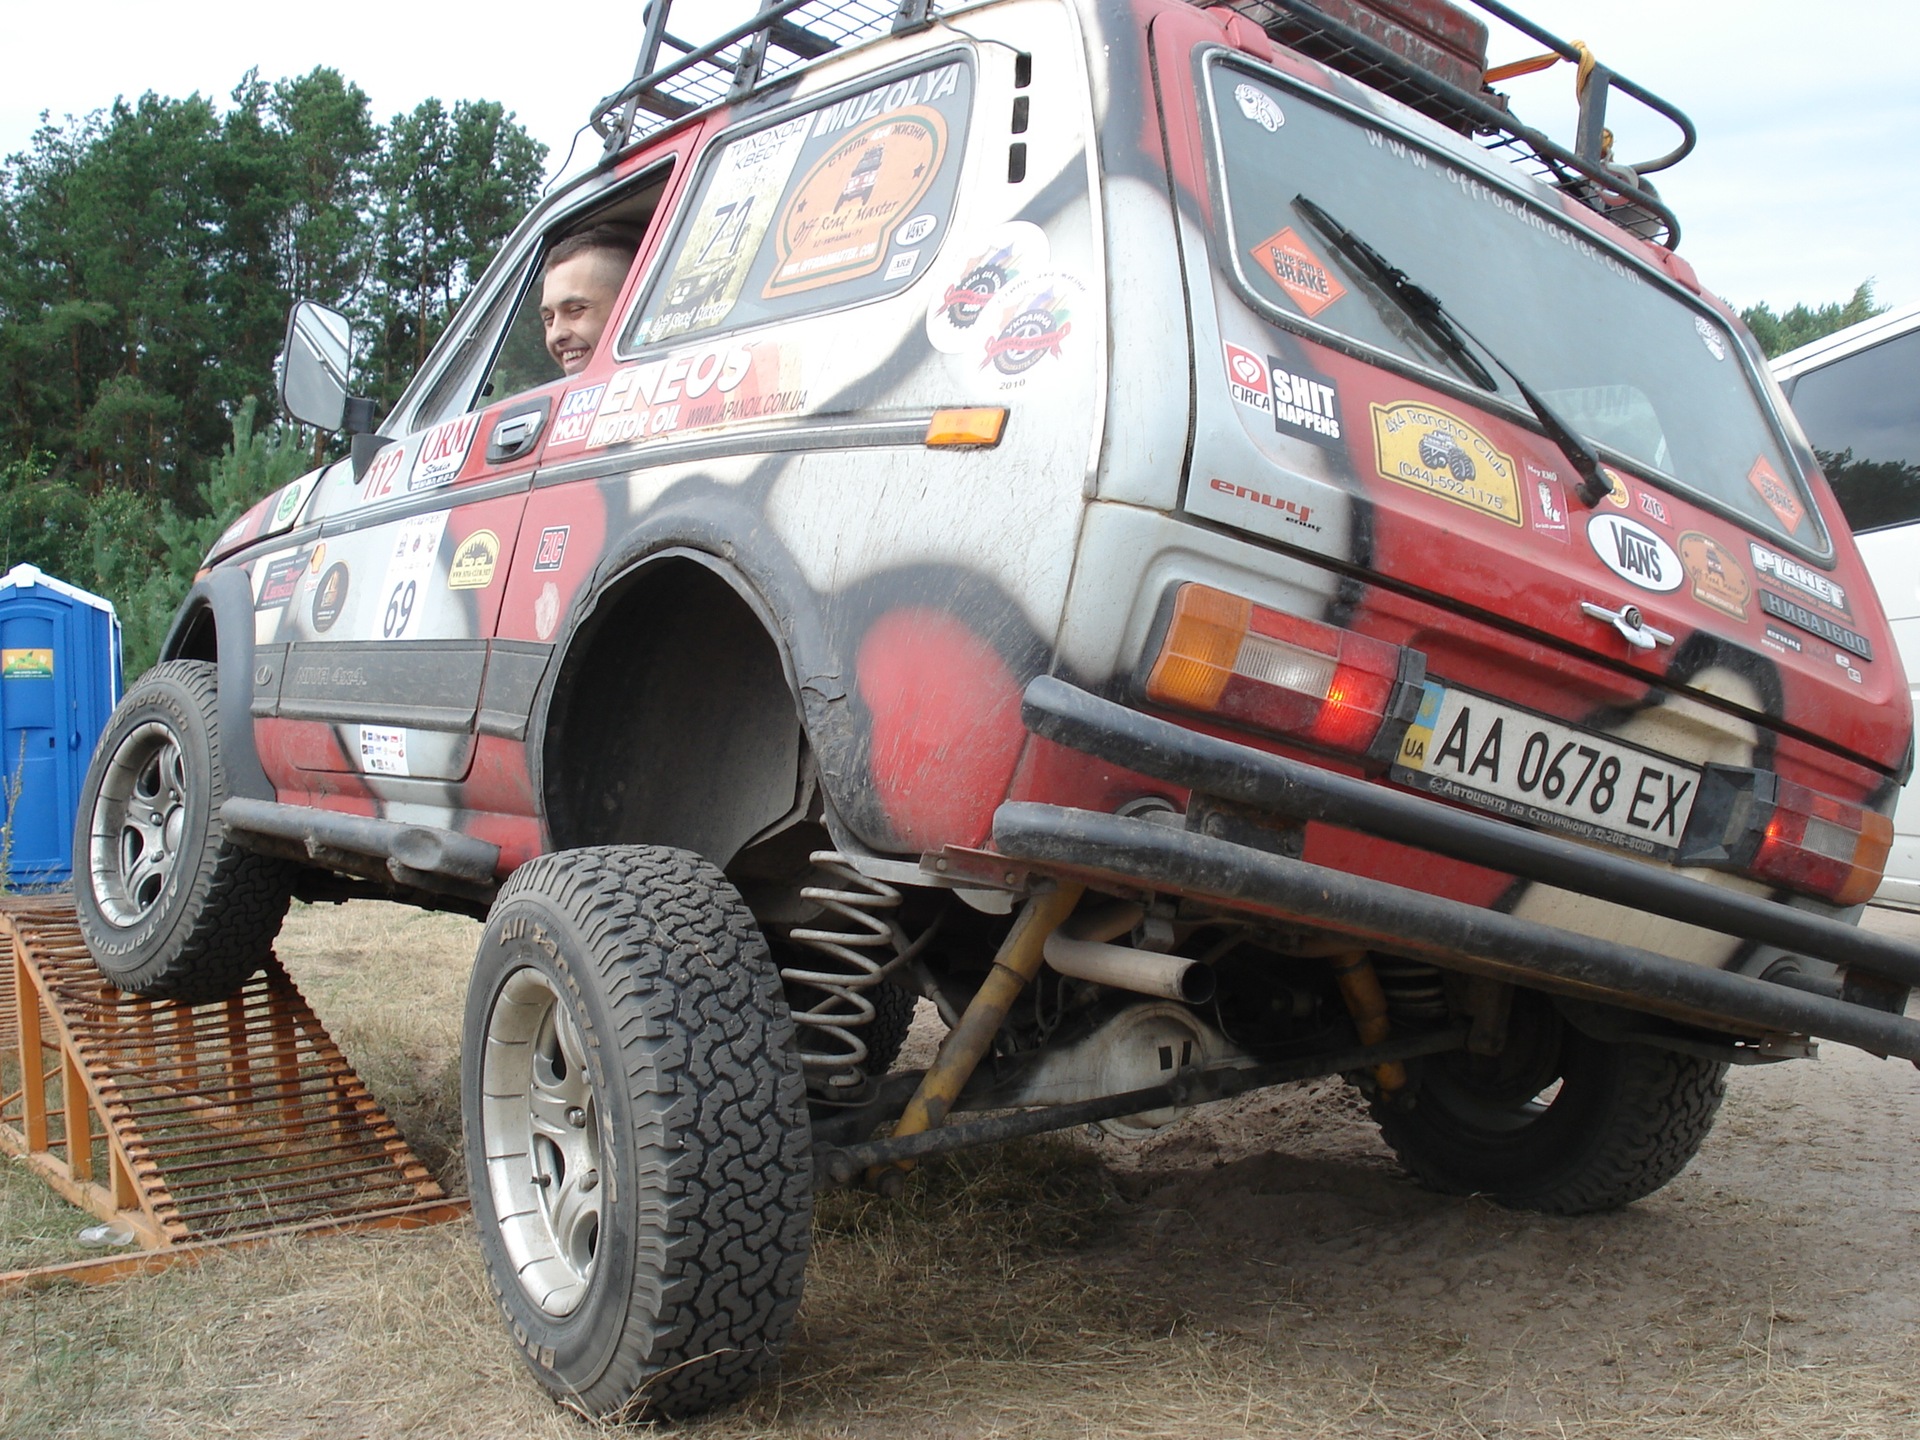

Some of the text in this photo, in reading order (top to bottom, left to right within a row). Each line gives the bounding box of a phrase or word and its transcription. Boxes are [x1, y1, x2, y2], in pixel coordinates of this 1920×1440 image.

[829, 64, 963, 131] MUZOLYA
[731, 117, 807, 158] ТИХОХОД
[733, 140, 787, 172] КВЕСТ
[828, 137, 869, 168] СТИЛЬ
[892, 124, 928, 142] ЖИЗНИ
[852, 200, 899, 225] Master
[905, 219, 929, 241] VANS
[1365, 128, 1641, 287] www.offroadmaster.com
[1274, 260, 1330, 296] BRAKE
[1005, 312, 1051, 335] УКРАИНА
[600, 345, 752, 416] ENEOS
[999, 379, 1026, 390] 2010
[1272, 367, 1335, 418] SHIT
[553, 413, 595, 440] MOLY
[588, 404, 681, 447] MOTOR OIL
[685, 390, 809, 428] WWW.JAPANOIL.COM.UA
[1276, 405, 1341, 441] HAPPENS
[422, 415, 477, 465] ORM
[1407, 409, 1469, 442] Rancho
[1473, 440, 1508, 479] Club
[363, 448, 405, 501] 112
[1399, 460, 1504, 511] (044)-592-1175
[1609, 520, 1662, 583] VANS
[1750, 542, 1846, 610] PLANET
[383, 579, 417, 639] 69
[1404, 737, 1424, 761] UA
[1434, 706, 1691, 837] AA 0678 EX
[1443, 781, 1655, 854] Автоцентр на Столичному 206-8000
